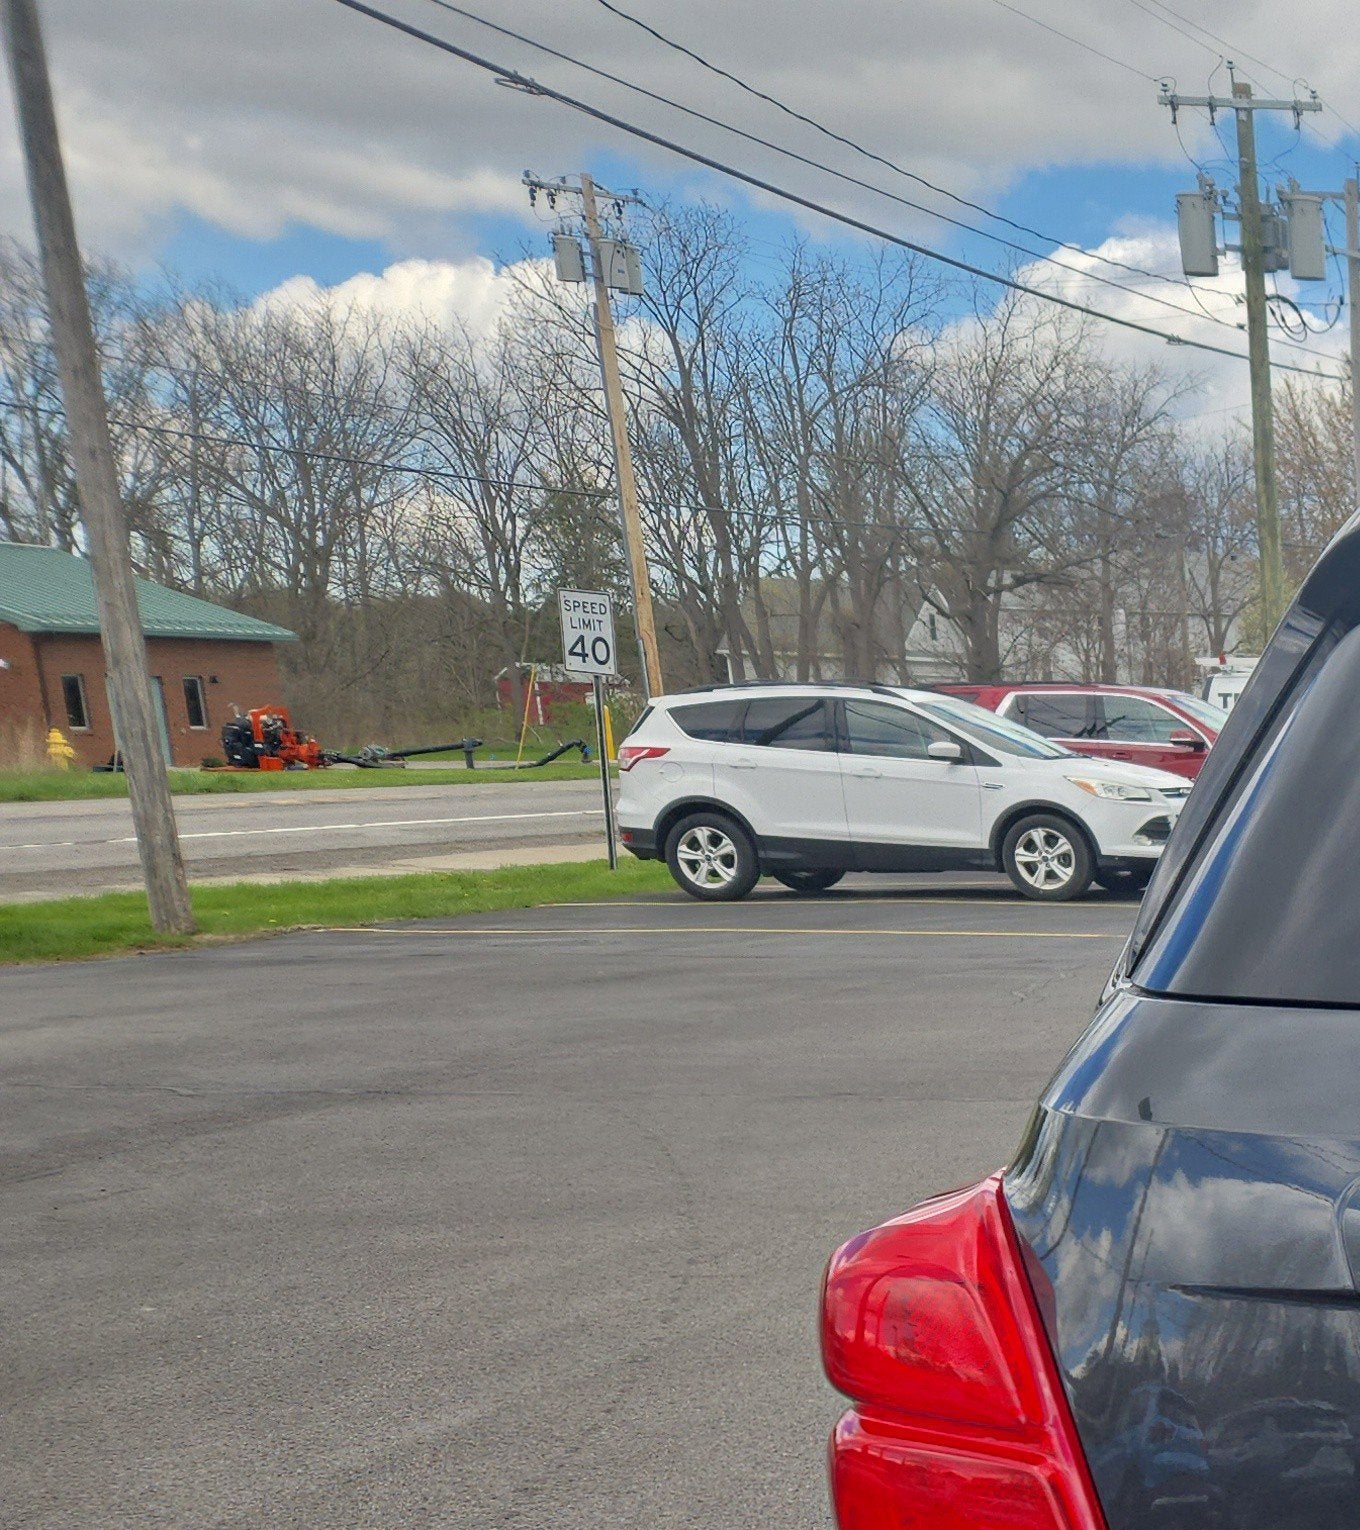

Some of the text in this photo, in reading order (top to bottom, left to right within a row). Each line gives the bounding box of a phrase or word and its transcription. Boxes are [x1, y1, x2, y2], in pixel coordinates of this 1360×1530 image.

[564, 599, 607, 615] SPEED
[570, 617, 603, 631] LIMIT
[568, 634, 610, 665] 40
